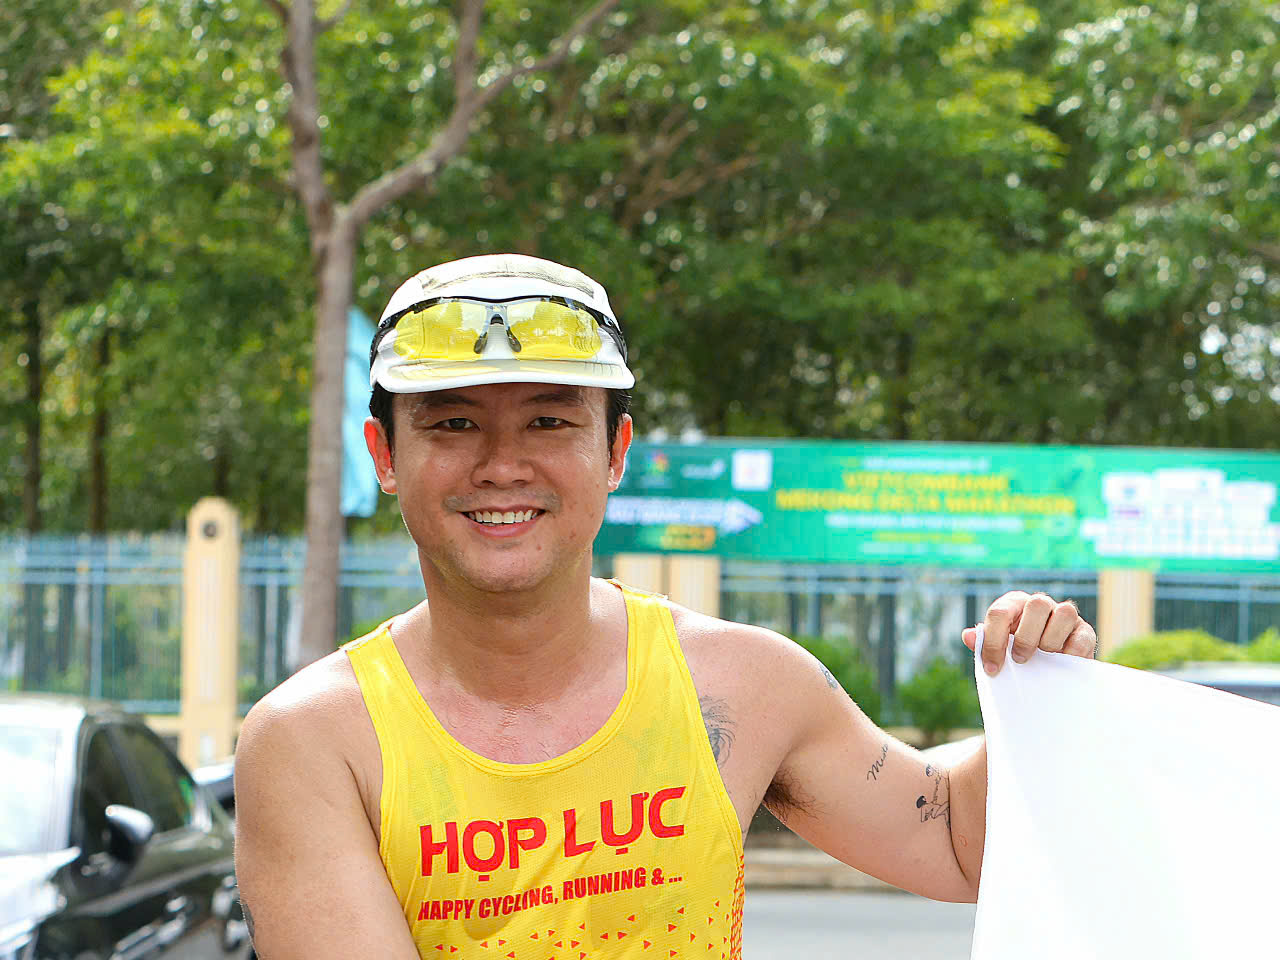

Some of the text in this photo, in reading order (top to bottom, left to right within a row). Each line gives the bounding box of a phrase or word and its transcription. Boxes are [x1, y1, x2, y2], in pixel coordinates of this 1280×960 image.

[419, 786, 687, 883] HỢP LỰC
[417, 898, 476, 922] HAPPY
[478, 884, 560, 919] CYCLING,
[562, 866, 647, 901] RUNNING
[651, 867, 666, 887] &
